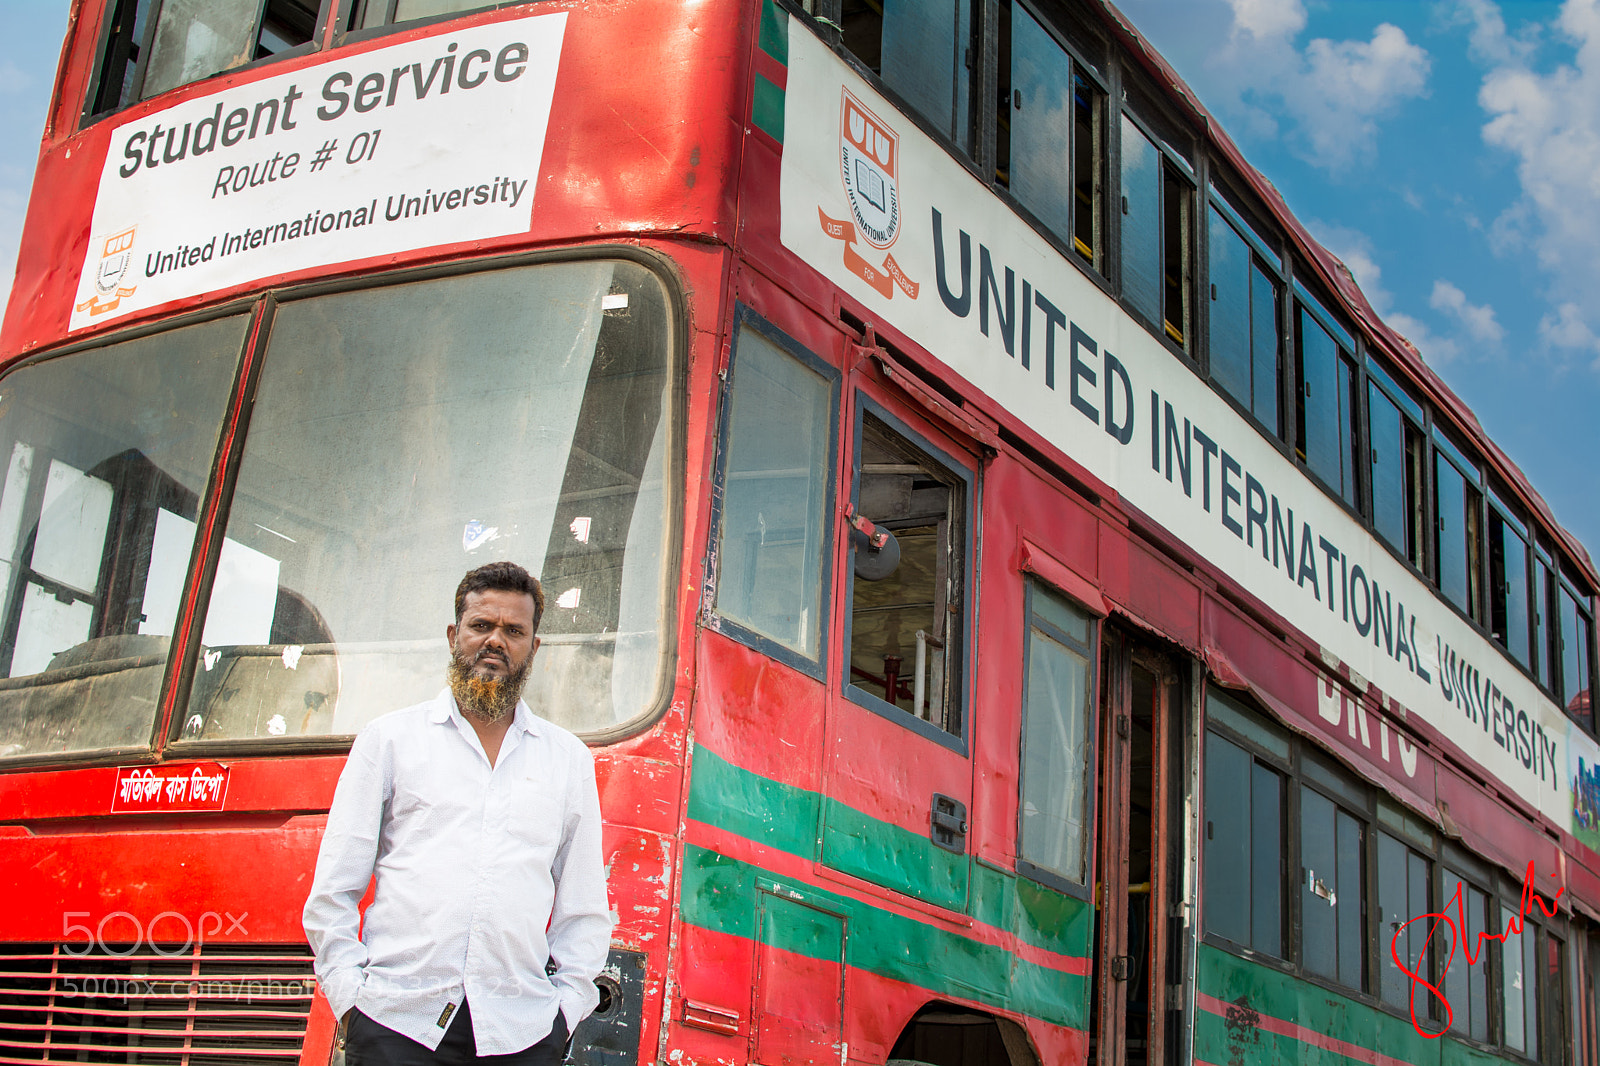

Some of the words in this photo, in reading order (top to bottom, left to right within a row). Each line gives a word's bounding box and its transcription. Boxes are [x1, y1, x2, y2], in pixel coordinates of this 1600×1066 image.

[119, 85, 302, 178] Student
[317, 41, 529, 121] Service
[849, 107, 890, 166] UIU
[211, 148, 300, 199] Route
[310, 139, 338, 173] #
[346, 129, 382, 165] 01
[842, 146, 851, 185] UNITED
[848, 188, 887, 241] INTERNATIONAL
[145, 235, 216, 277] United
[221, 200, 376, 255] International
[384, 176, 528, 221] University
[827, 222, 843, 236] QUEST
[864, 267, 875, 282] FOR
[931, 207, 1135, 446] UNITED
[1150, 388, 1431, 684] INTERNATIONAL
[1436, 633, 1558, 791] UNIVERSITY
[120, 768, 165, 803] মতিঝিল
[166, 773, 189, 803] বাস
[189, 767, 225, 802] ডিপো
